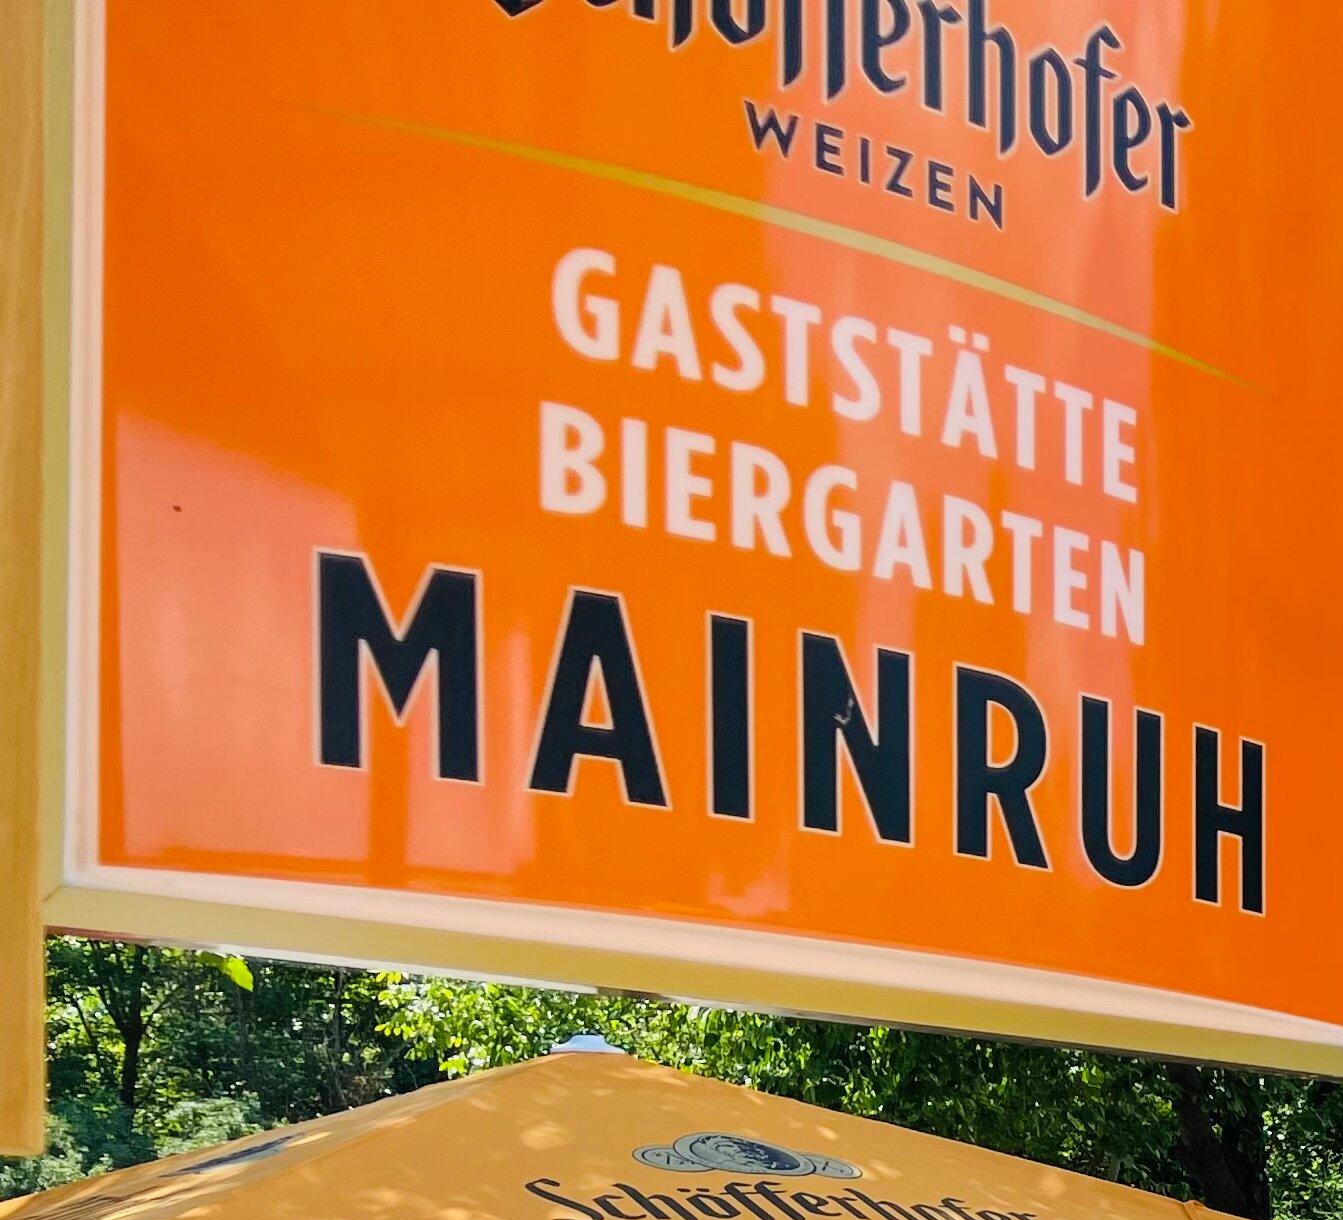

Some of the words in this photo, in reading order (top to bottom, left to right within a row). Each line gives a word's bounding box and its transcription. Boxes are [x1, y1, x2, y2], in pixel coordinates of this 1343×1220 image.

[743, 99, 1004, 231] WEIZEN
[551, 247, 1139, 504] GASTSTÄTTE
[539, 400, 1146, 647] BIERGARTEN
[313, 548, 1267, 917] MAINRUH
